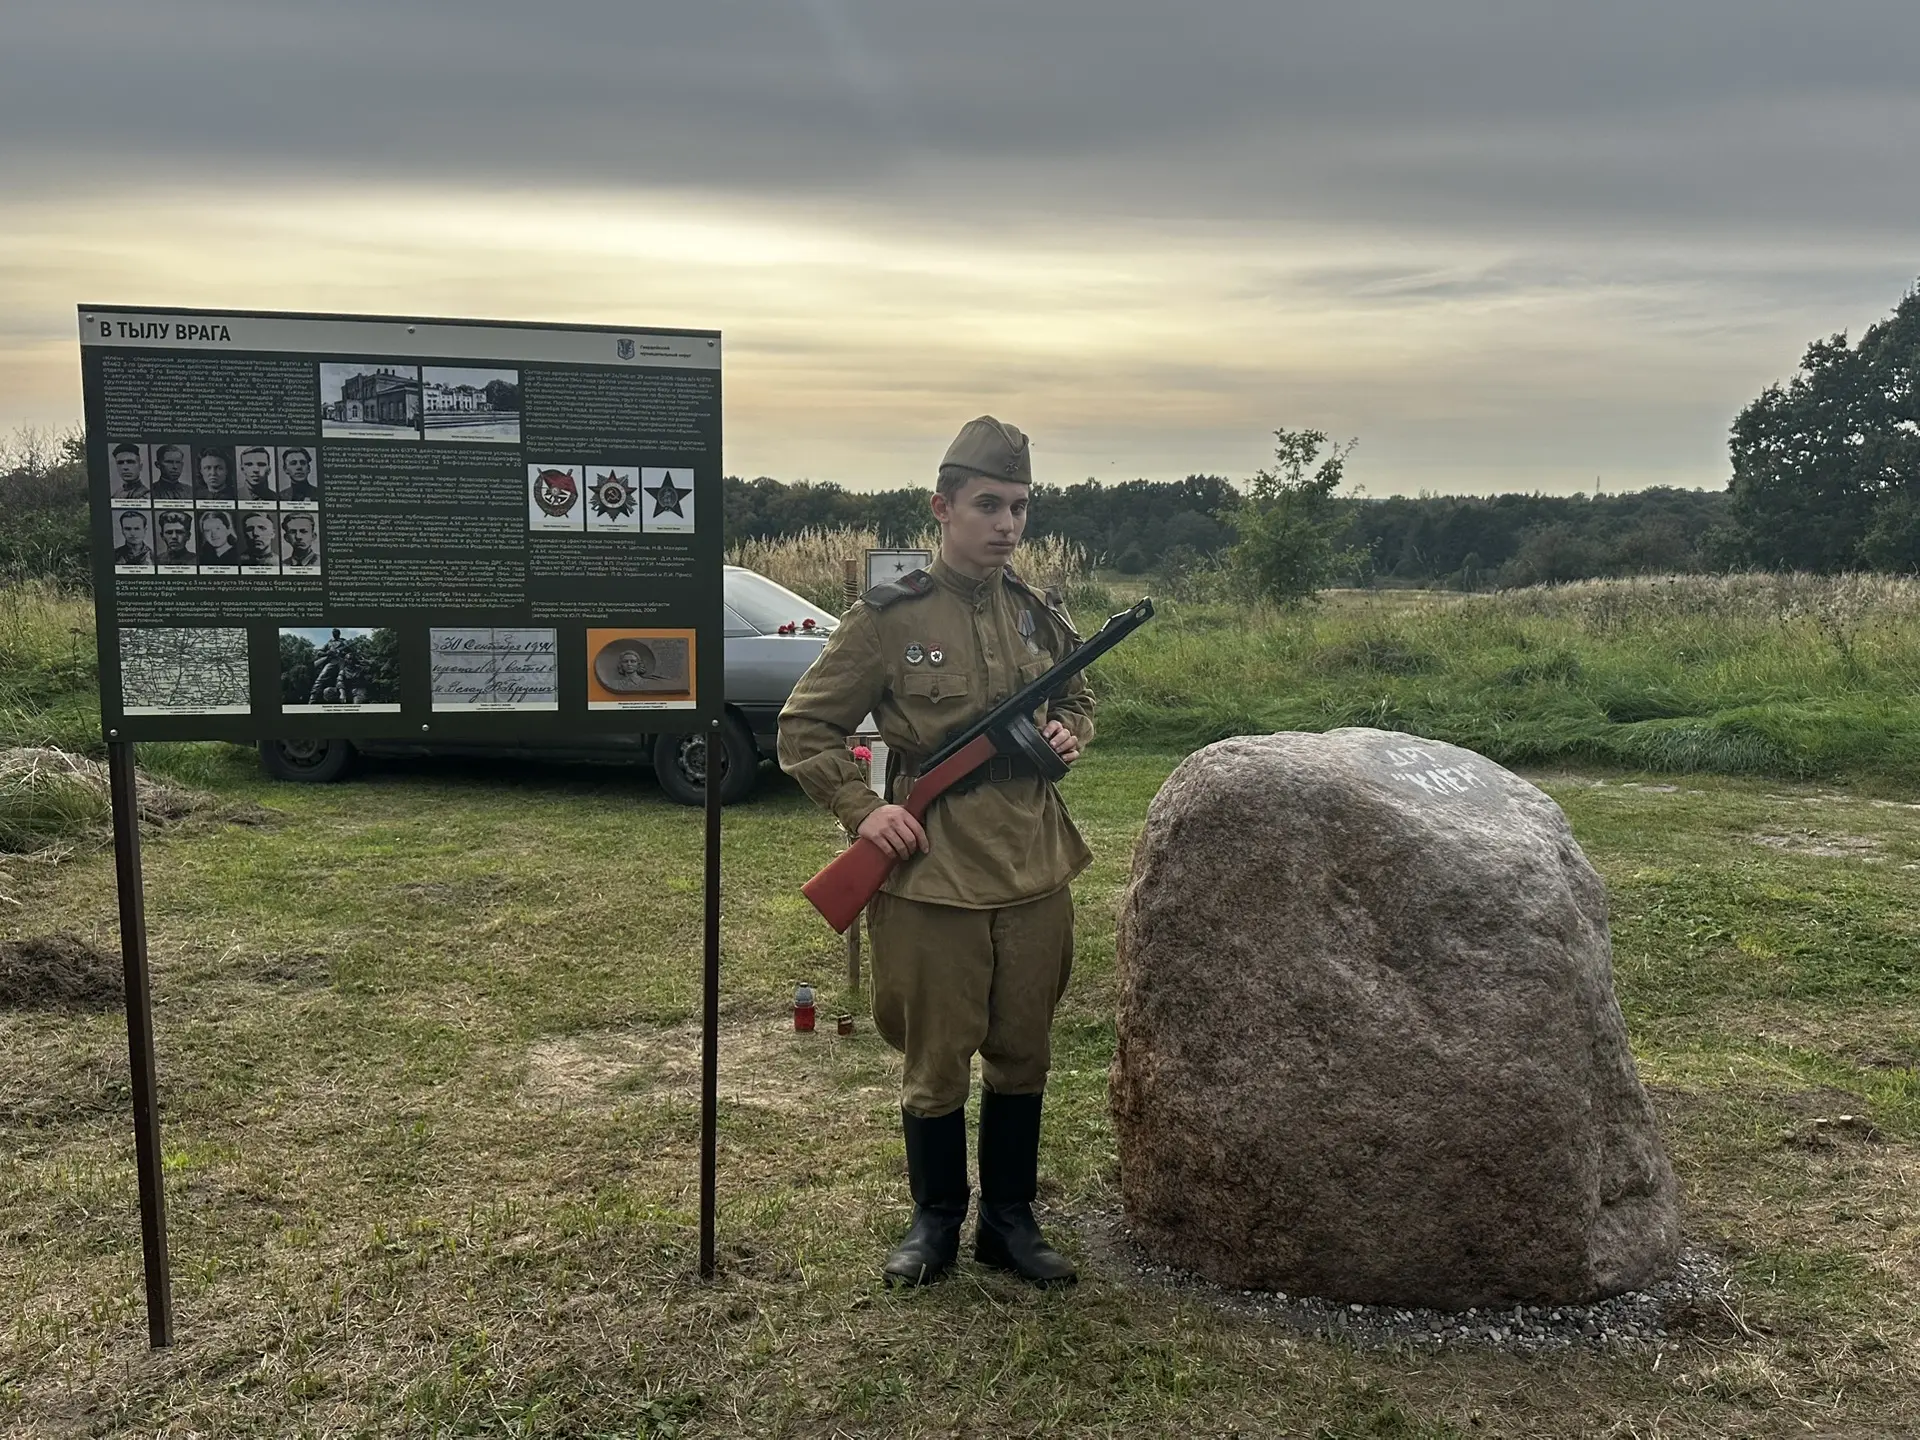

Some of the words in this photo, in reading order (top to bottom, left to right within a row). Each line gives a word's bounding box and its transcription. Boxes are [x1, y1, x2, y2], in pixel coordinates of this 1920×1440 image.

[99, 321, 111, 338] В
[116, 322, 169, 339] ТЫЛУ
[176, 324, 231, 342] ВРАГА
